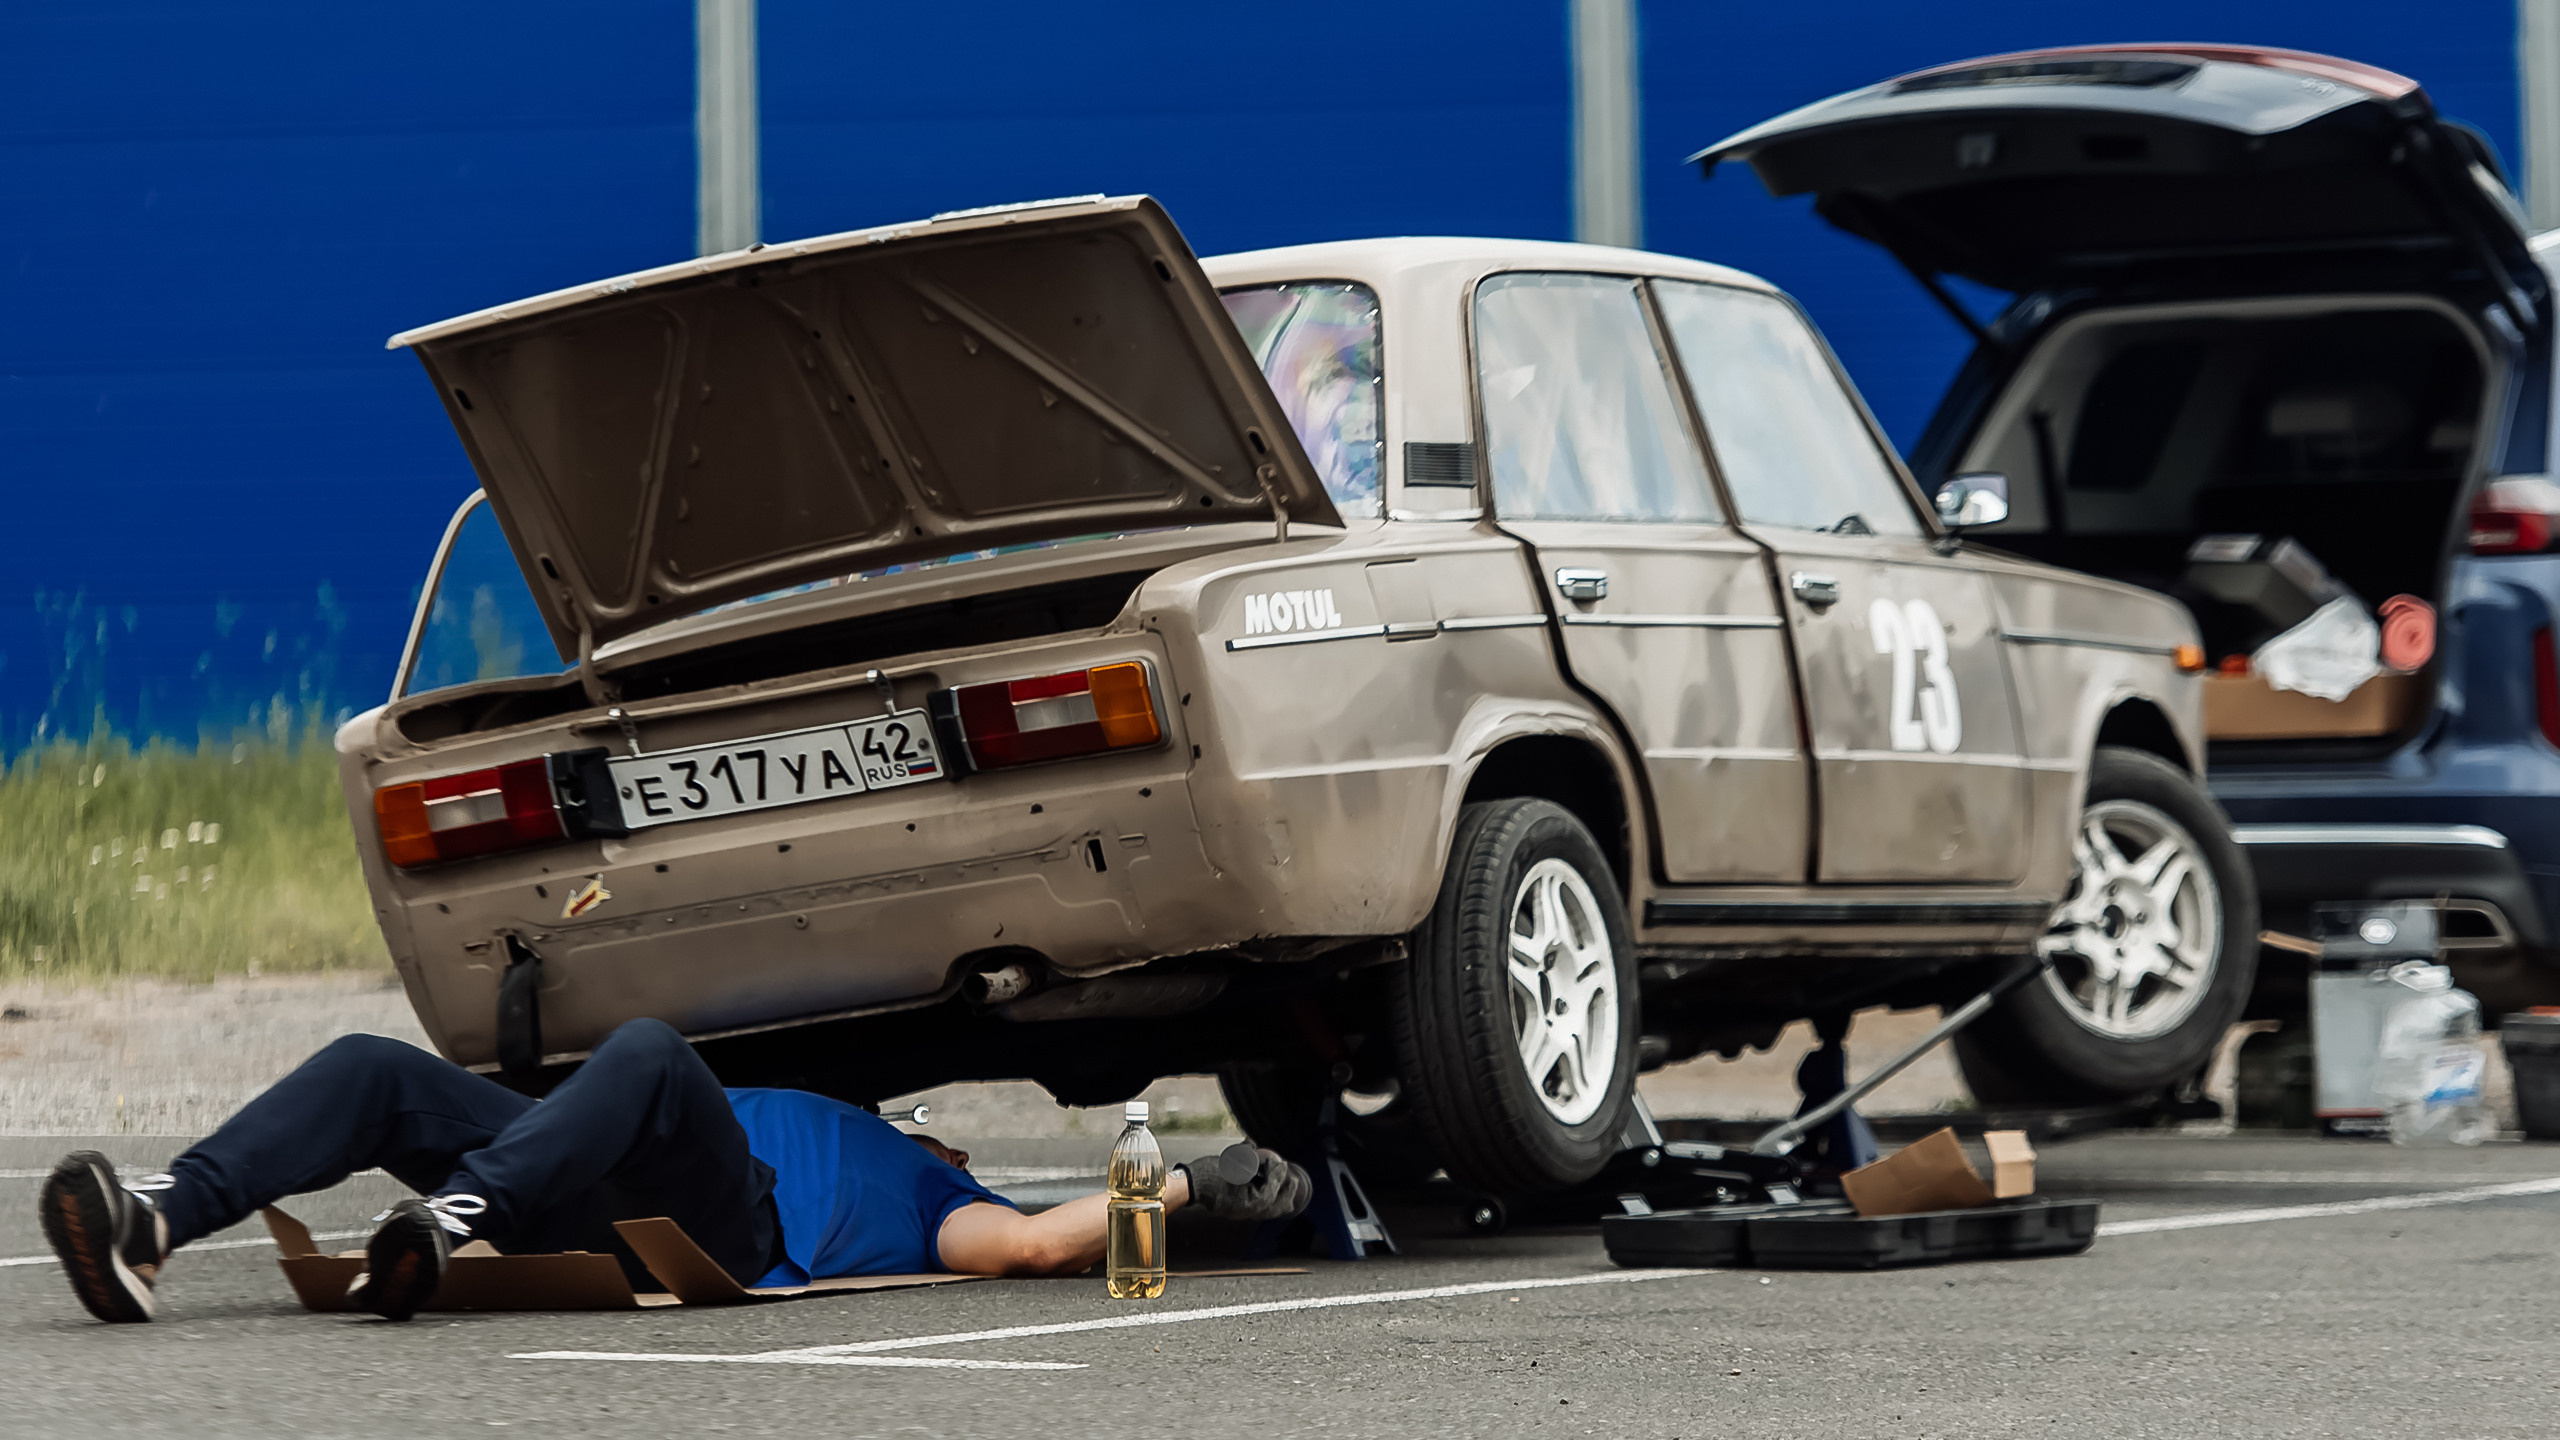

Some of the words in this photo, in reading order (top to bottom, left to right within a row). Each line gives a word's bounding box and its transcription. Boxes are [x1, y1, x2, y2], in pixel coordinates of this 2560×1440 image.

[1245, 589, 1341, 635] MOTUL
[1869, 598, 1962, 754] 23
[861, 722, 918, 763] 42
[867, 762, 907, 783] RUS
